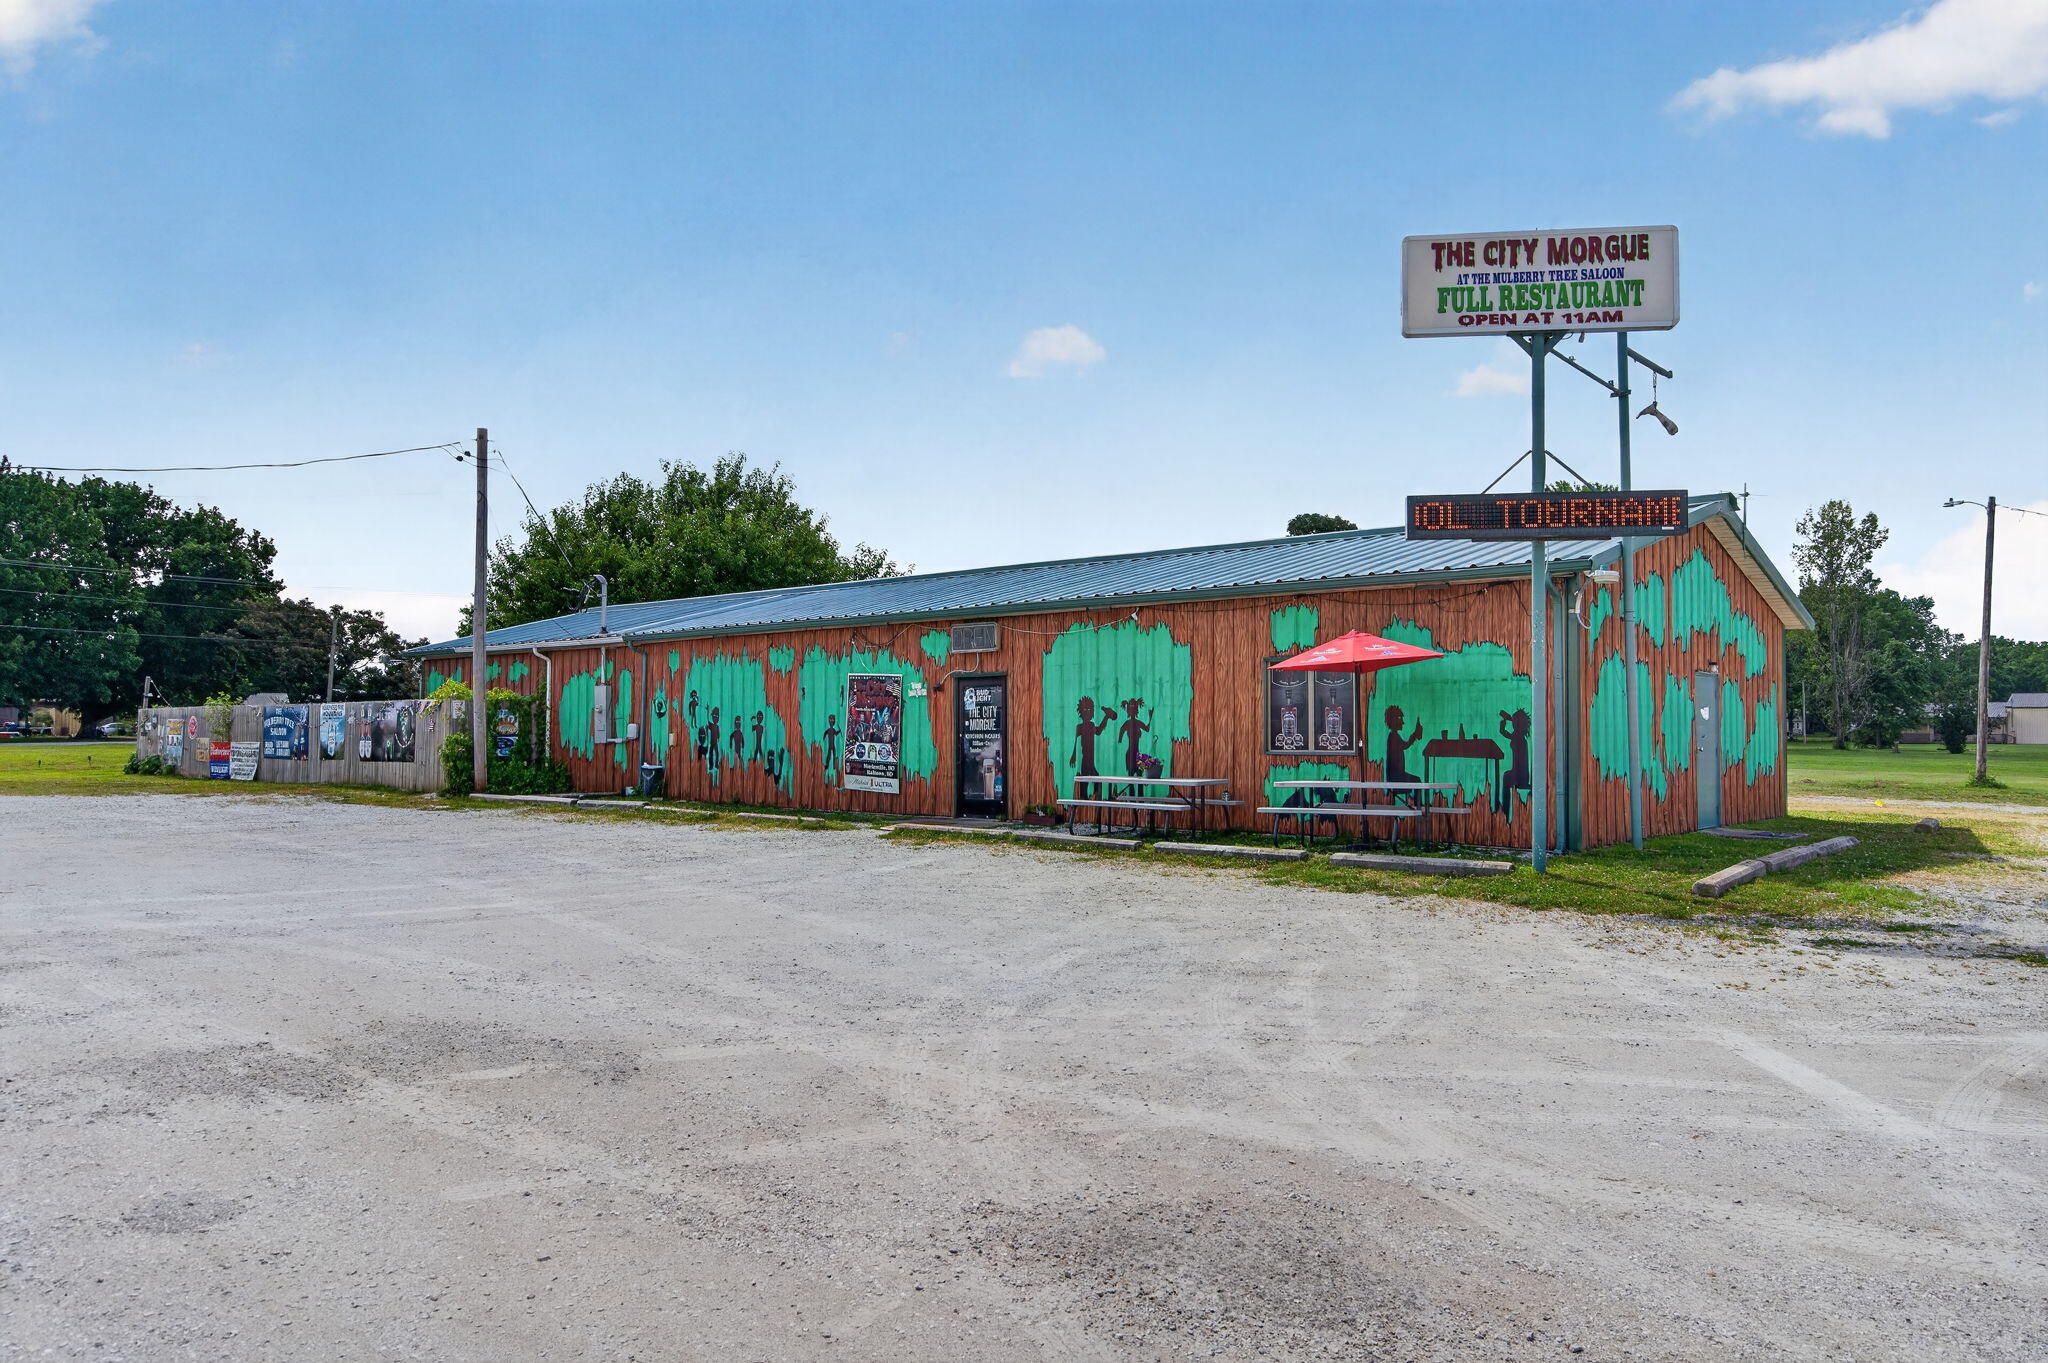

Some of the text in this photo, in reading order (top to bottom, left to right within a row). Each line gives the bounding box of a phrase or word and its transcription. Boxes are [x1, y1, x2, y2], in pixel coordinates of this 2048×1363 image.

[1431, 234, 1649, 272] THE CITY MORGUE
[1457, 267, 1625, 285] AT THE MULBERRY TREE SALOON
[1437, 279, 1645, 313] FULL RESTAURANT
[1457, 310, 1624, 326] OPEN AT 11AM
[1414, 501, 1472, 530] OL
[969, 705, 998, 718] THE CITY
[969, 718, 997, 731] MORGUE
[874, 780, 893, 788] ULTRA
